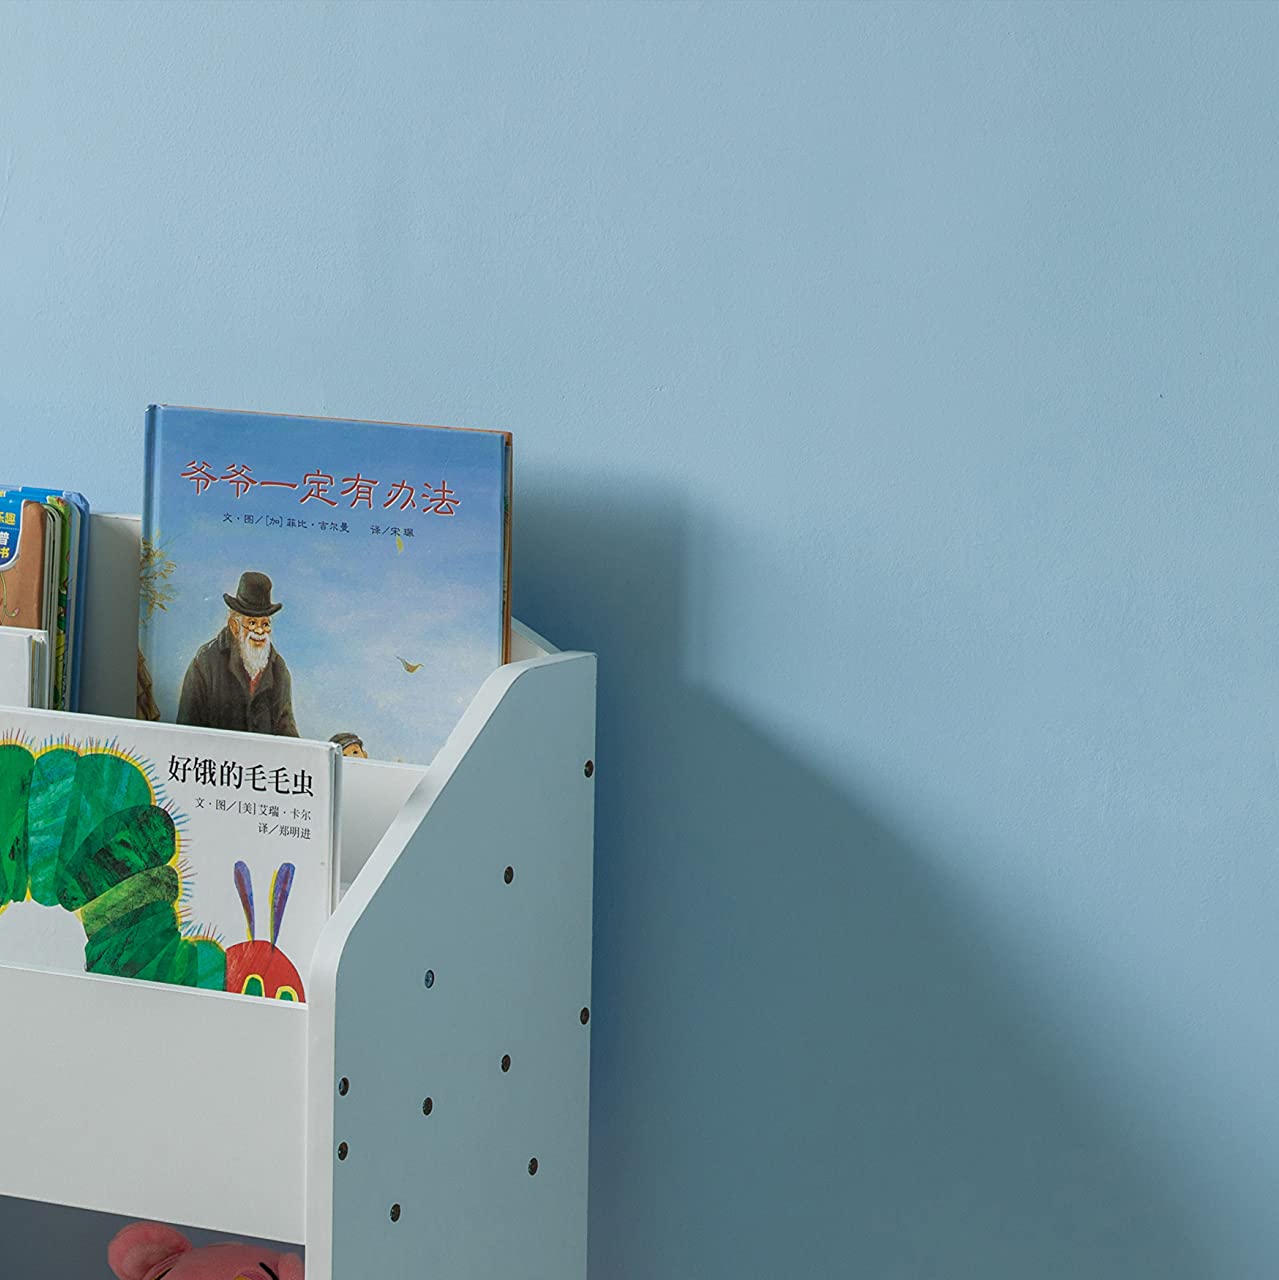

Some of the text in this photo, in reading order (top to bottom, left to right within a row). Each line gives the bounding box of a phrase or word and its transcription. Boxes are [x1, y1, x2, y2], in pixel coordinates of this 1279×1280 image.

[180, 460, 460, 516] 爷爷一定有办法
[168, 754, 314, 797] 好饿的毛毛虫
